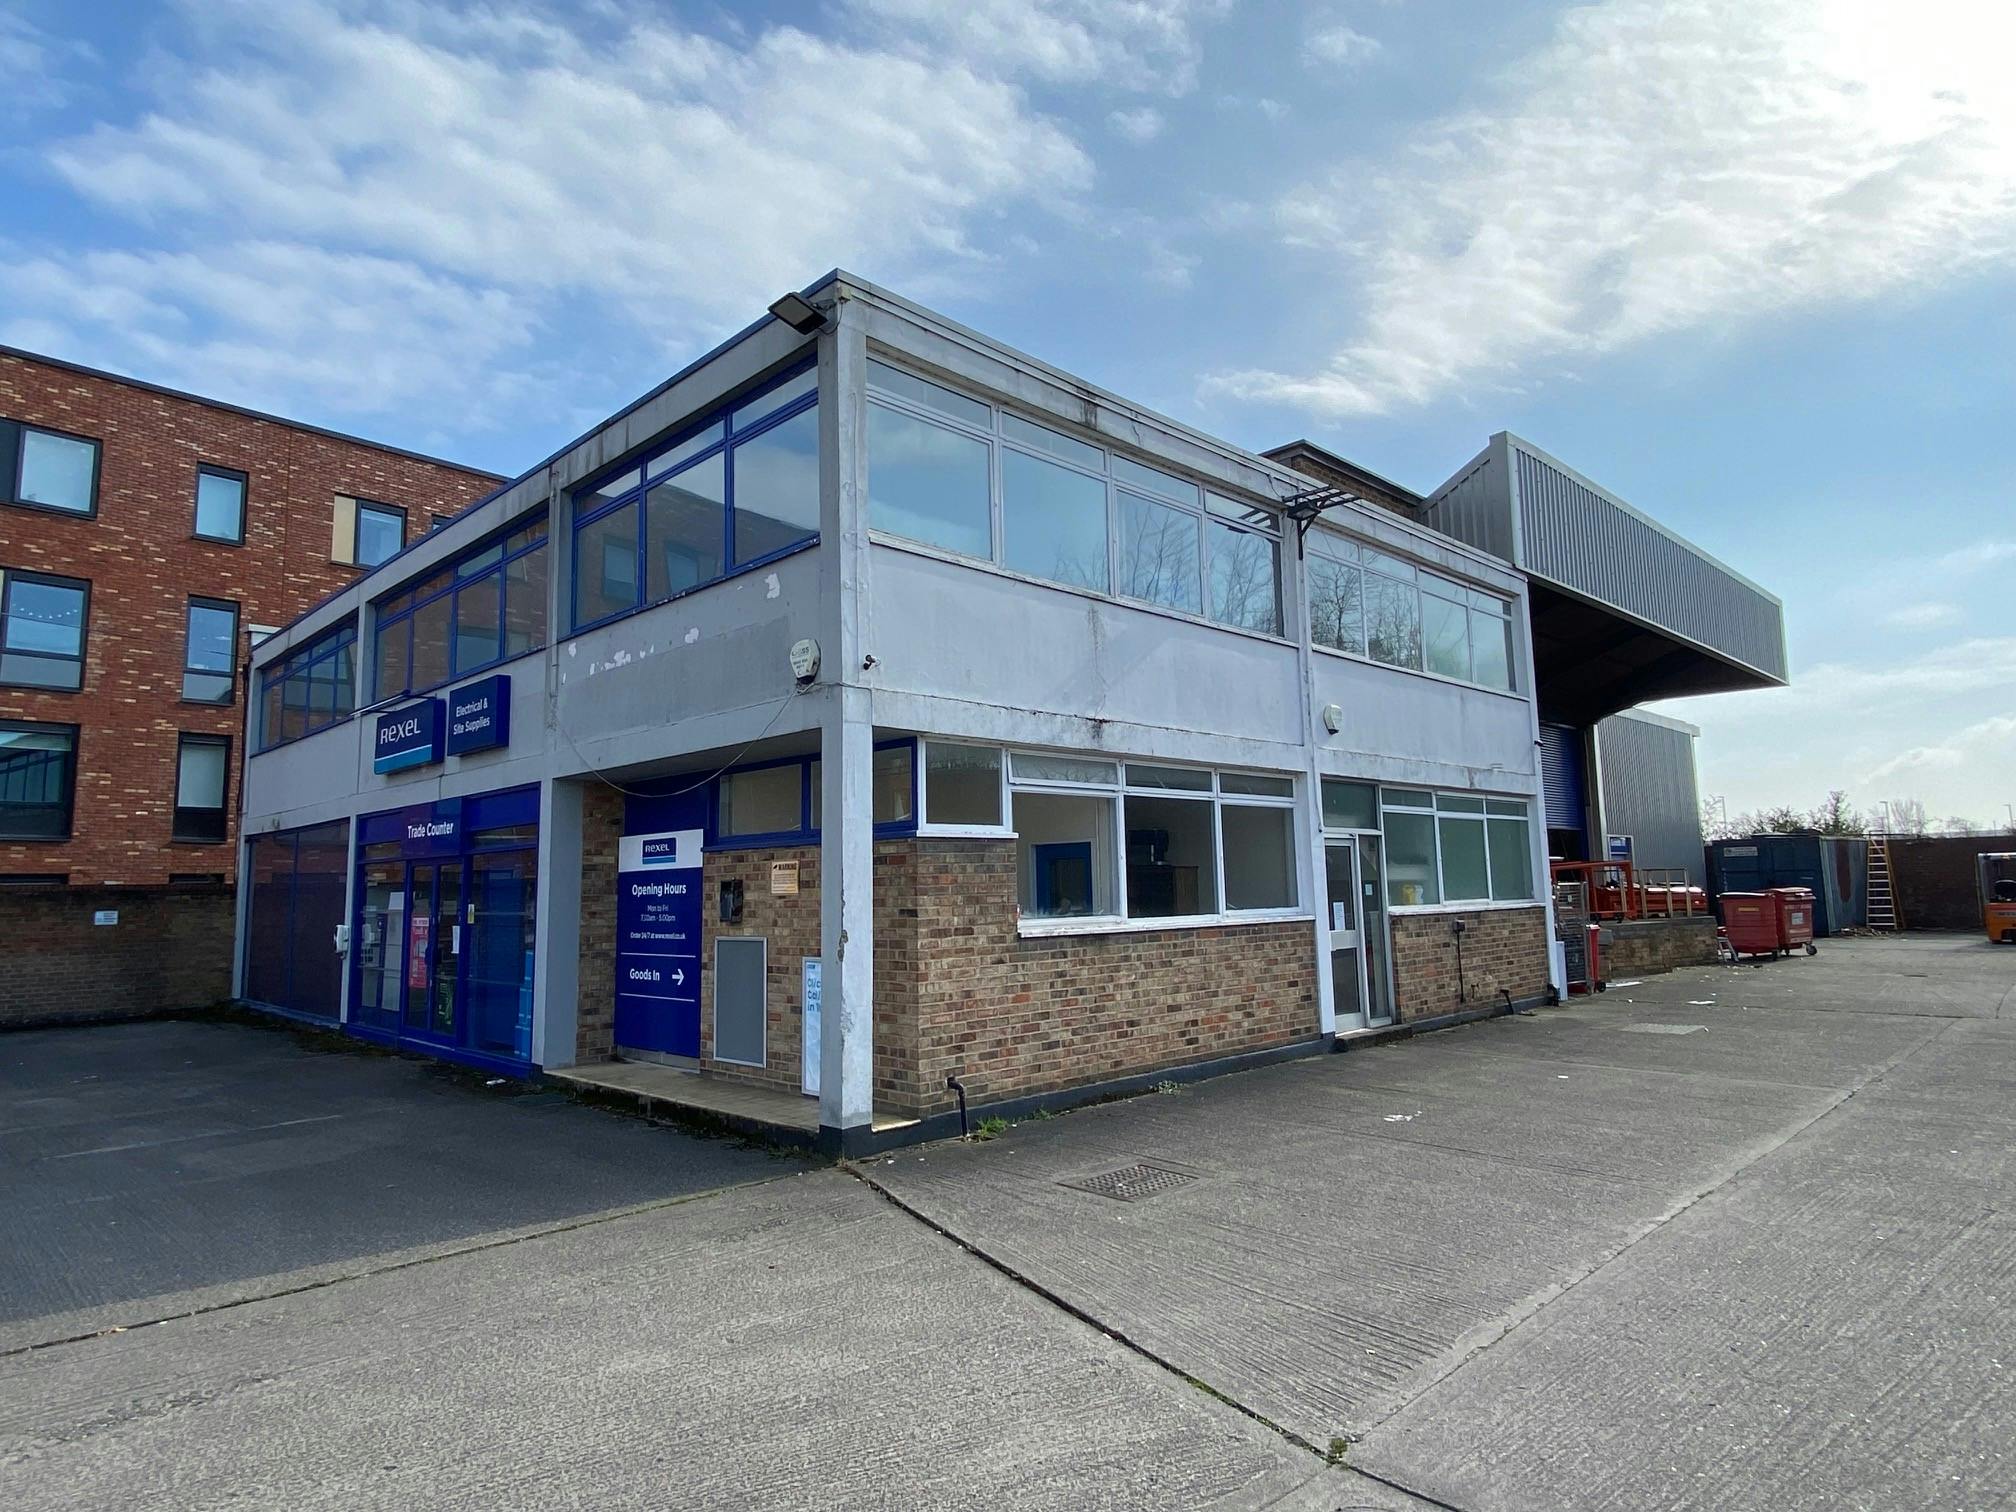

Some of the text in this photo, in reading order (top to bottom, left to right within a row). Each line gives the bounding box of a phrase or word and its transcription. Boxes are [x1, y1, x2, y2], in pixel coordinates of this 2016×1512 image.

[456, 699, 483, 717] Electrical
[453, 716, 490, 735] Site Supplies
[407, 821, 454, 839] Trade Counter
[632, 882, 687, 898] Opening Hours
[629, 968, 660, 981] Goods In
